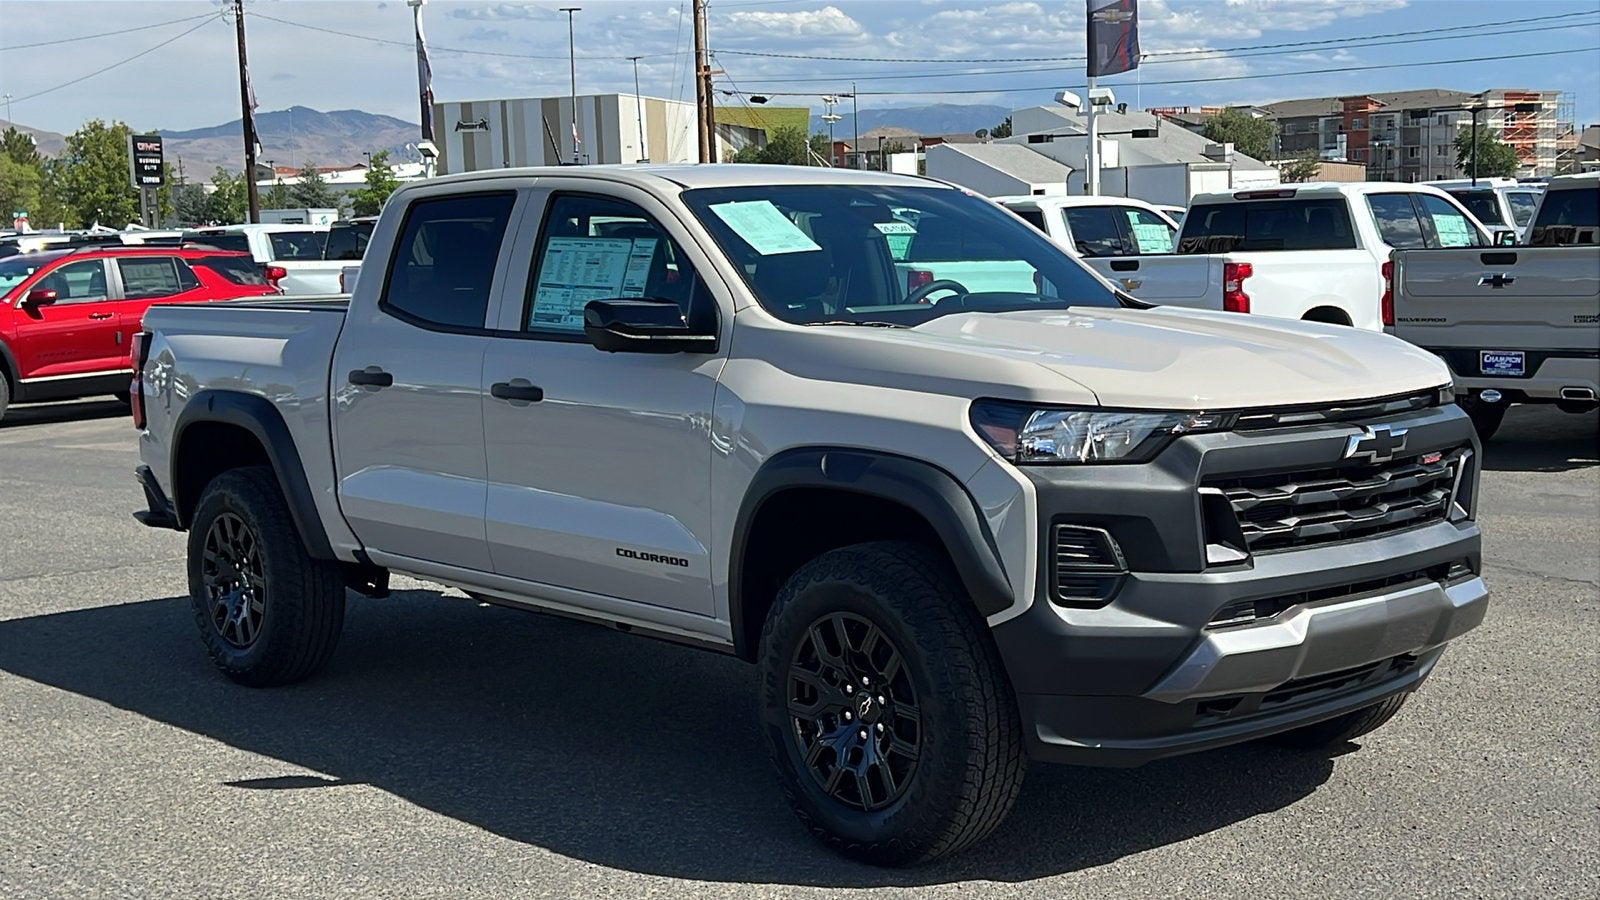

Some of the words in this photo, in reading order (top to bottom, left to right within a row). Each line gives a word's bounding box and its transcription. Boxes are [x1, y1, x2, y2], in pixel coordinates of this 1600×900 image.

[137, 142, 160, 151] GMC
[1483, 354, 1522, 363] CHAMPION
[616, 547, 689, 567] COLORADO
